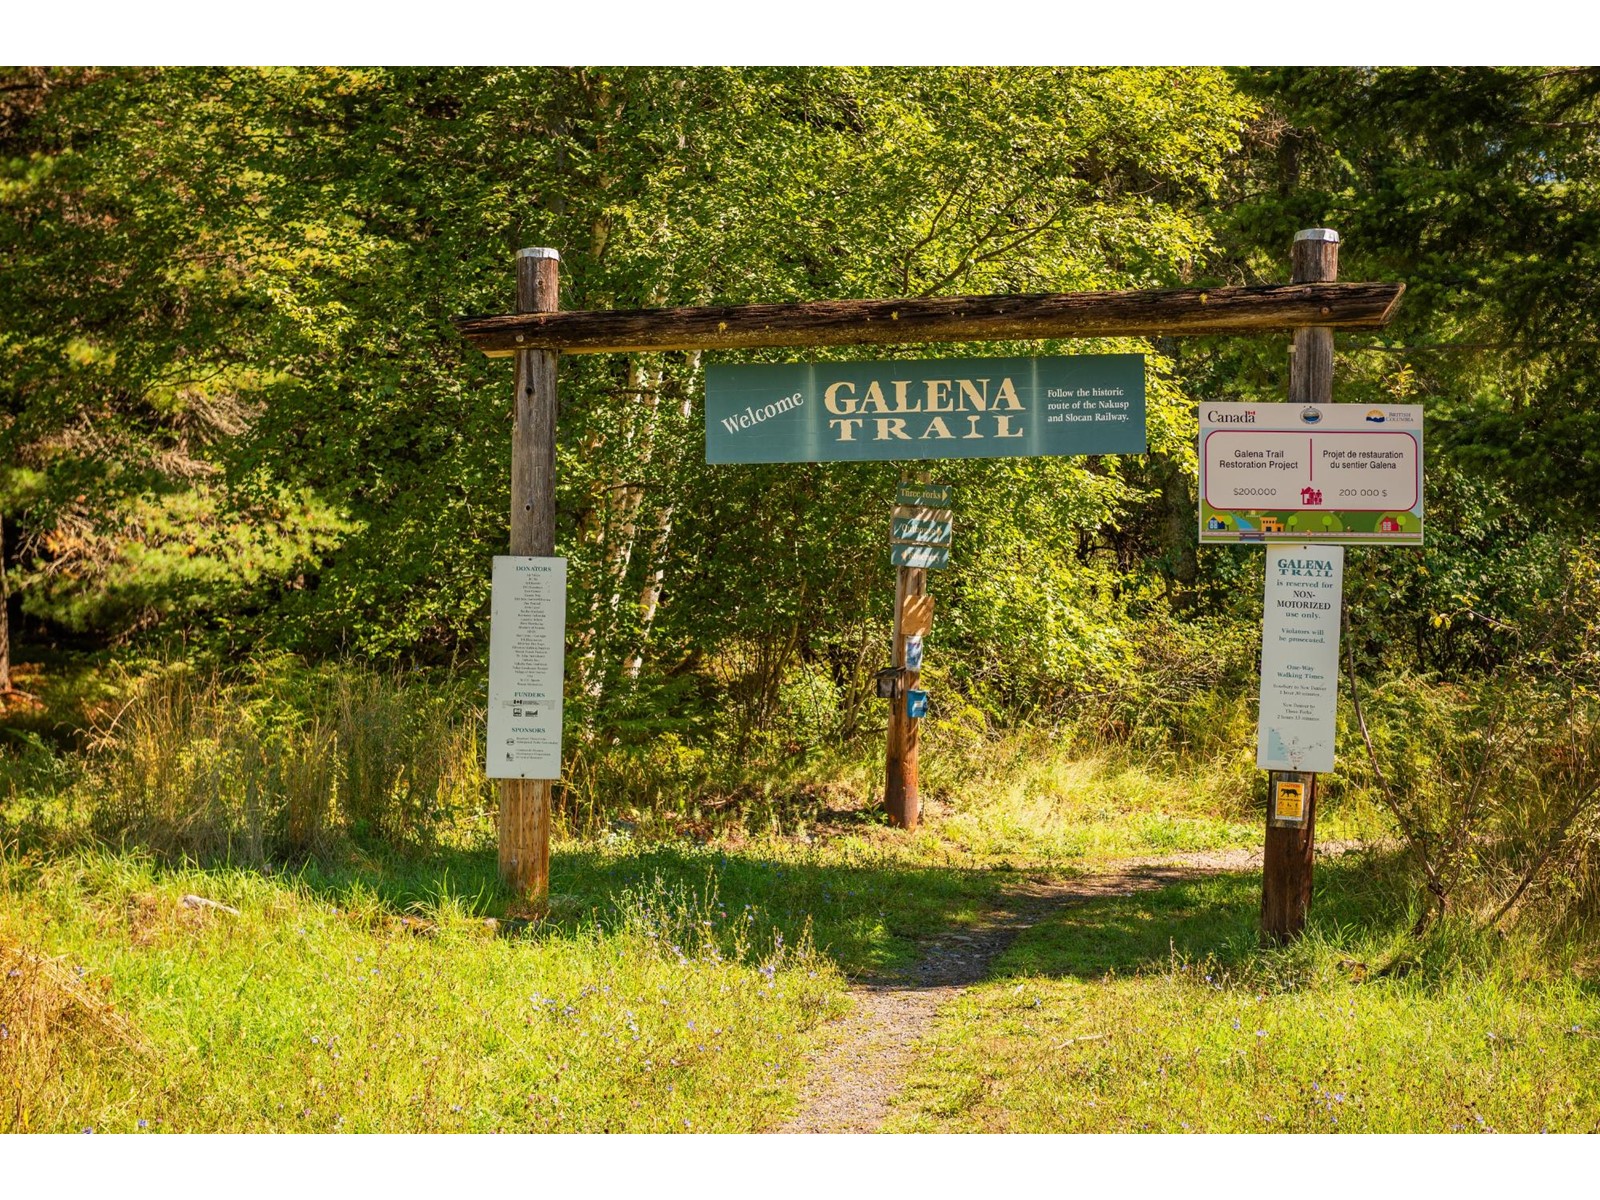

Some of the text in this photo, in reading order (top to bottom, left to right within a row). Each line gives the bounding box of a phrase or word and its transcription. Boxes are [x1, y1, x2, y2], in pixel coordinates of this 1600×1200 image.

[824, 377, 1026, 415] GALENA
[1047, 387, 1124, 398] Follow the historic
[1047, 400, 1130, 411] route of the Nakusp
[721, 392, 804, 435] Welcome
[1047, 412, 1130, 424] and Slocan Railway.
[1207, 410, 1255, 423] Canada
[829, 415, 1024, 441] TRAIL
[1234, 450, 1284, 458] Galena Trail
[1322, 450, 1404, 460] Projet de restauration
[1219, 460, 1298, 470] Restoration Project
[1330, 461, 1397, 470] du sentier Galena
[1339, 489, 1388, 498] 200 000 $
[1277, 559, 1333, 570] GALENA
[1278, 569, 1333, 577] TRAIL
[1293, 590, 1316, 599] NON-
[1276, 600, 1331, 610] MOTORIZED
[1301, 612, 1321, 620] only.
[1281, 627, 1310, 635] Violators
[1288, 636, 1326, 644] prosecuted.
[1286, 664, 1314, 672] One-Way
[1277, 672, 1303, 680] Walking
